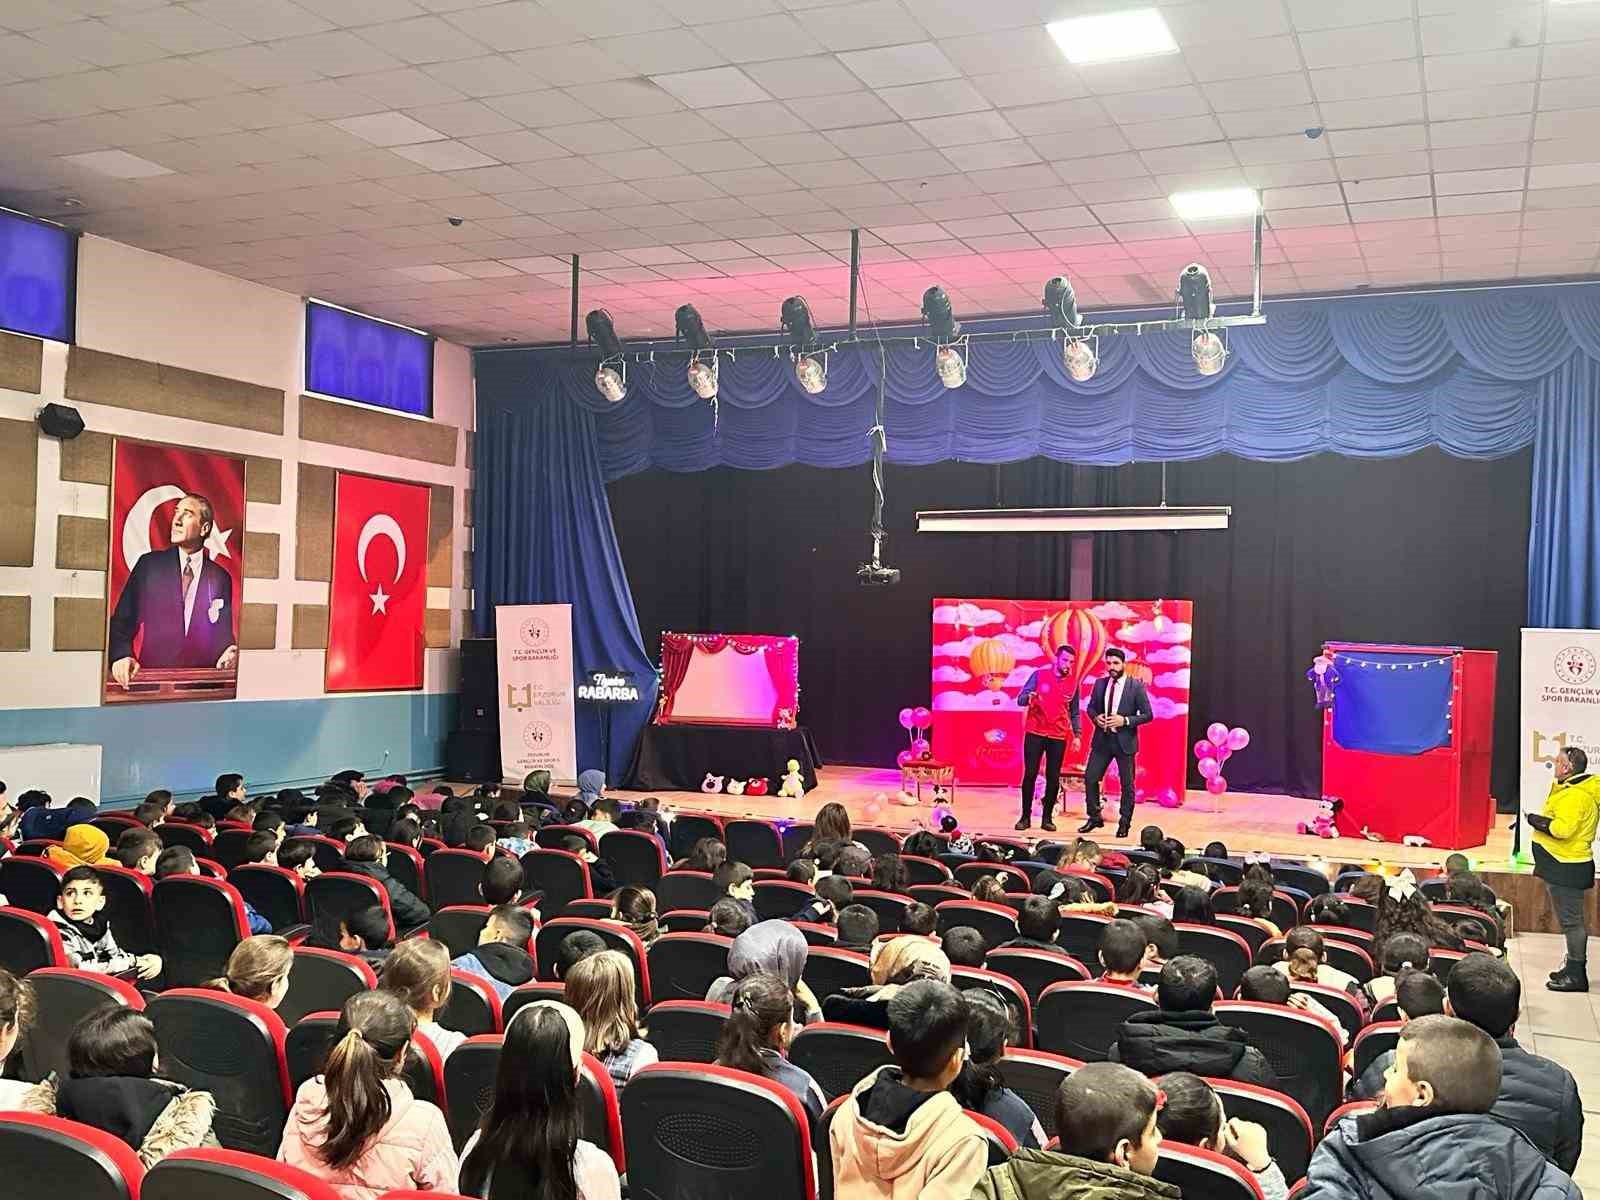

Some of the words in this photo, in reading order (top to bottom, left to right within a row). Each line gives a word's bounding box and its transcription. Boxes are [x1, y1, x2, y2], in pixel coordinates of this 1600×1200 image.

[578, 686, 639, 700] RABARBA
[1544, 686, 1558, 694] T.C.
[1560, 687, 1594, 696] GENÇLİK
[1564, 696, 1600, 704] BAKANLI
